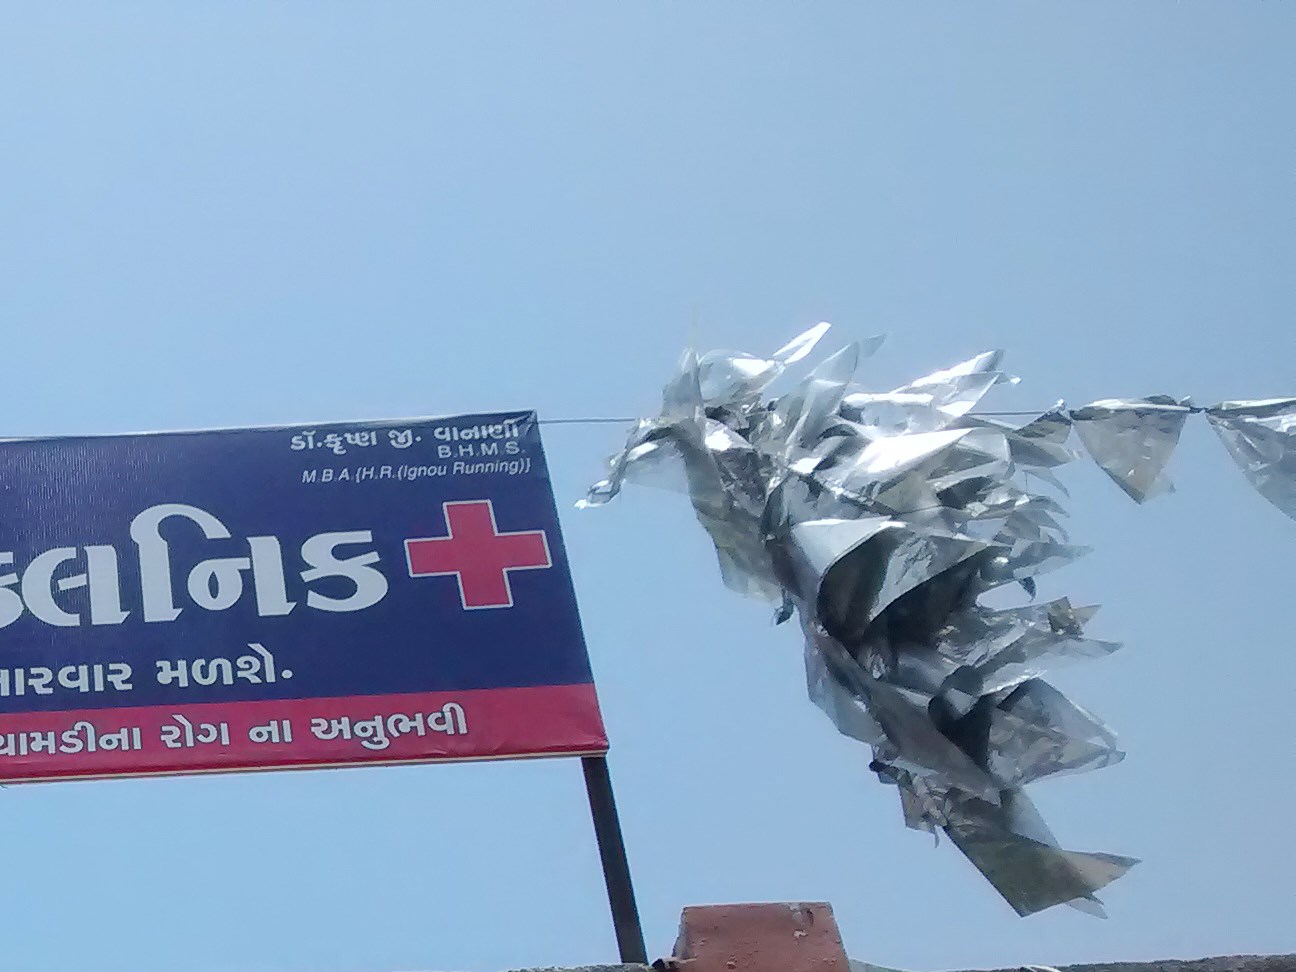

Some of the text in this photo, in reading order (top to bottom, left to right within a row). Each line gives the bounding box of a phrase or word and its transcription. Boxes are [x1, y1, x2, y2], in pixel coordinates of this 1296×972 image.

[155, 643, 293, 688] મળશે.
[160, 714, 231, 748] રોગ
[248, 719, 293, 744] ના
[310, 702, 469, 750] અનુભવી
